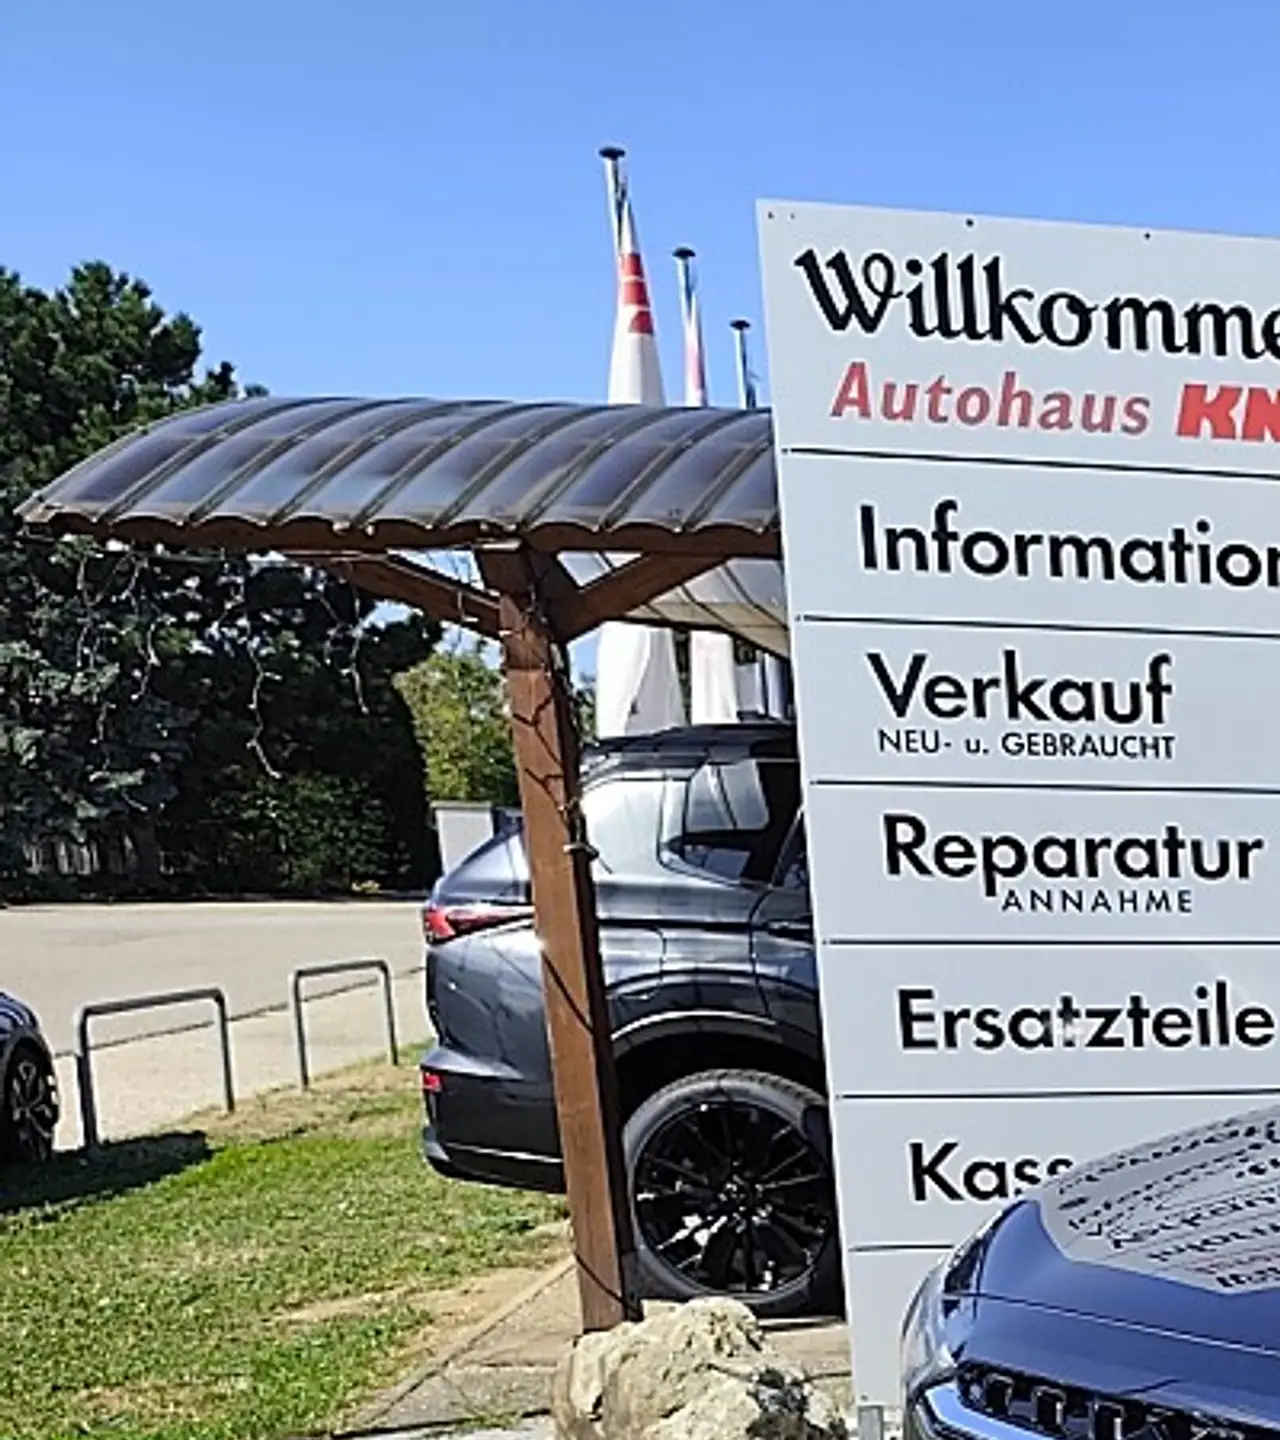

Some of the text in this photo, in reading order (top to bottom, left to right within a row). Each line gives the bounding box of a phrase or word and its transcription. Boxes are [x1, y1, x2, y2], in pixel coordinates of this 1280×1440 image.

[831, 361, 1150, 435] Autohaus
[866, 649, 1173, 725] Verkauf
[877, 728, 1177, 760] NEU- u. GEBRAUCHT
[883, 813, 1265, 897] Reparatur
[1001, 888, 1193, 914] ANNAHME
[898, 980, 1276, 1050] Ersatzteile
